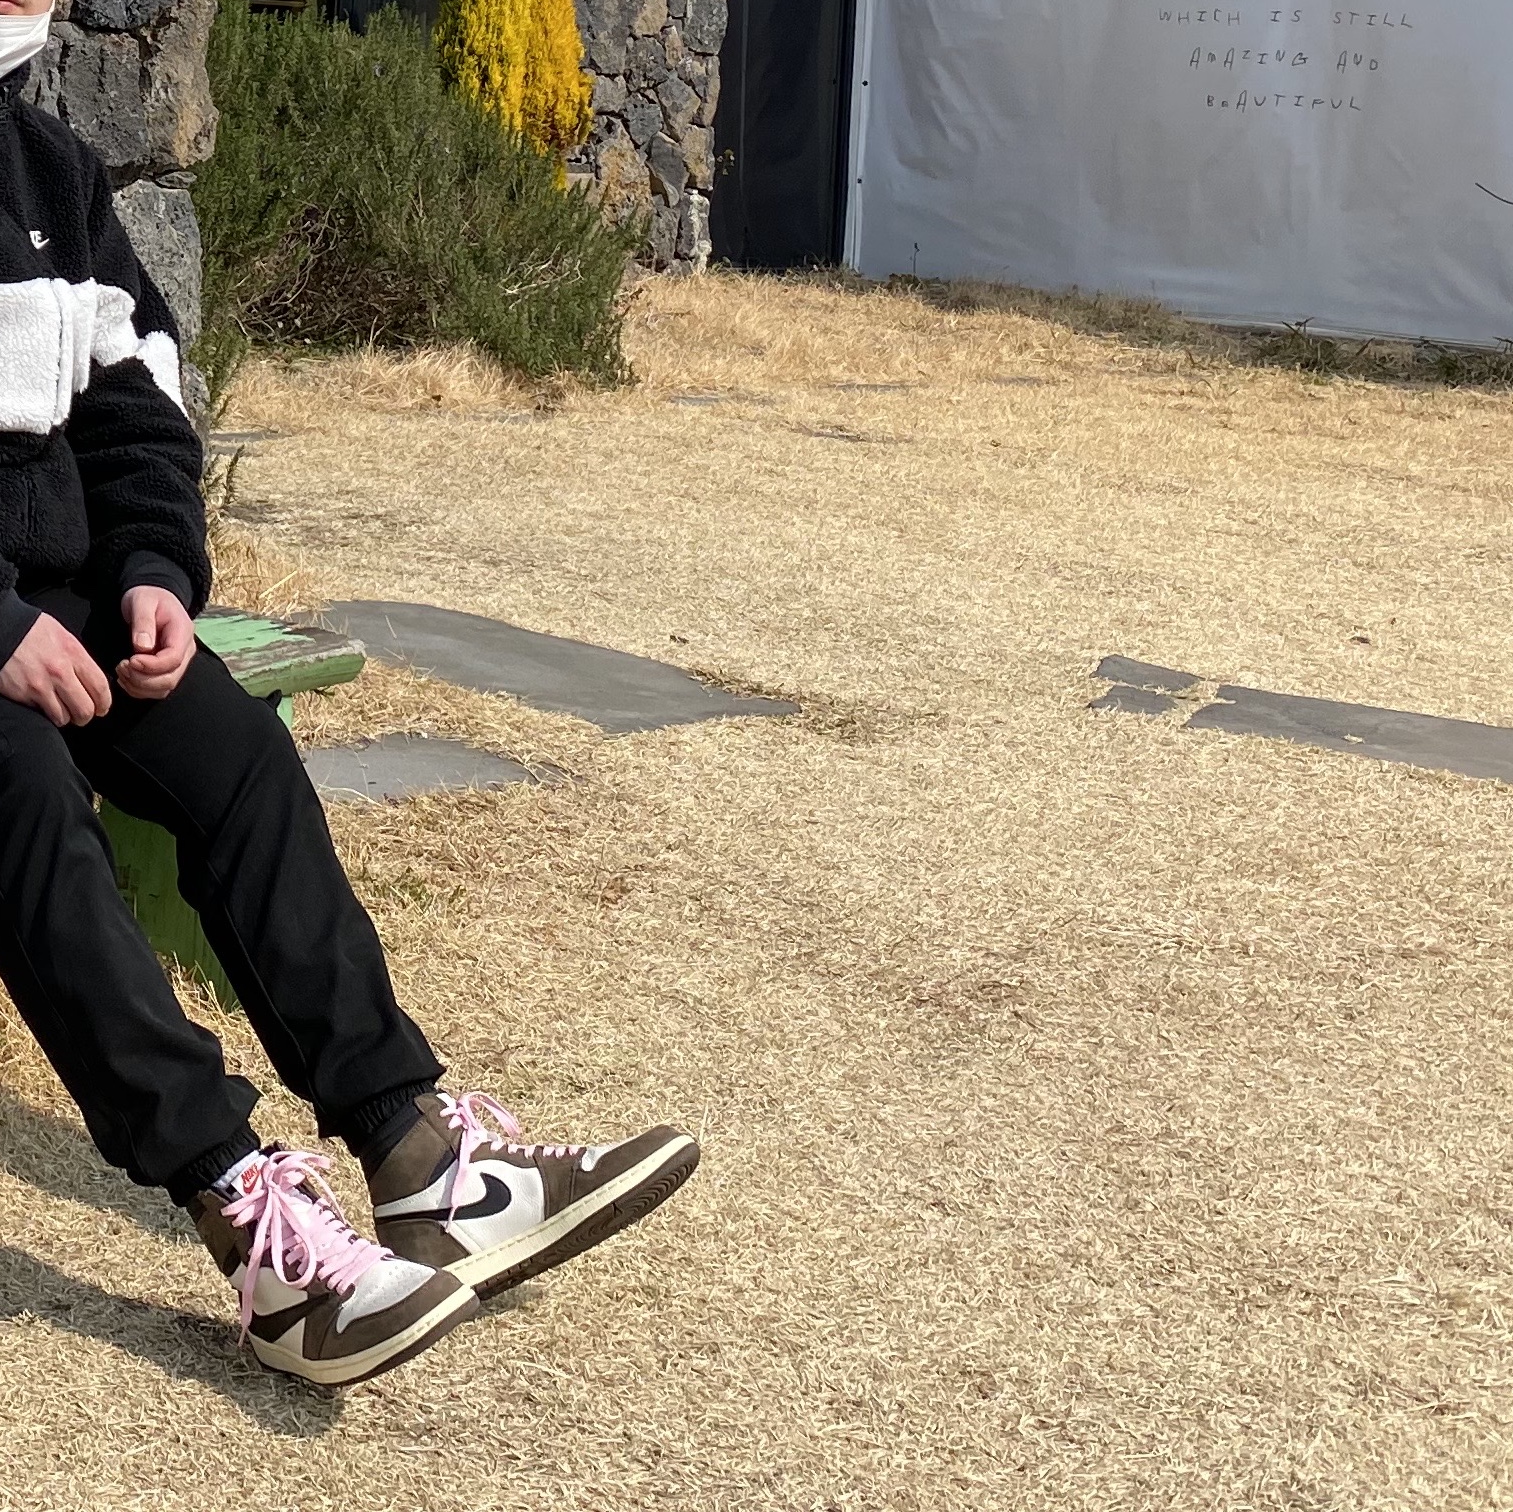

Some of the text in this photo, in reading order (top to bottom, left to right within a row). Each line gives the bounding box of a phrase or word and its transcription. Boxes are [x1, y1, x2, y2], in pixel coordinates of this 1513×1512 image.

[1159, 7, 1413, 29] WHICH IS STILL
[1336, 49, 1379, 74] AND
